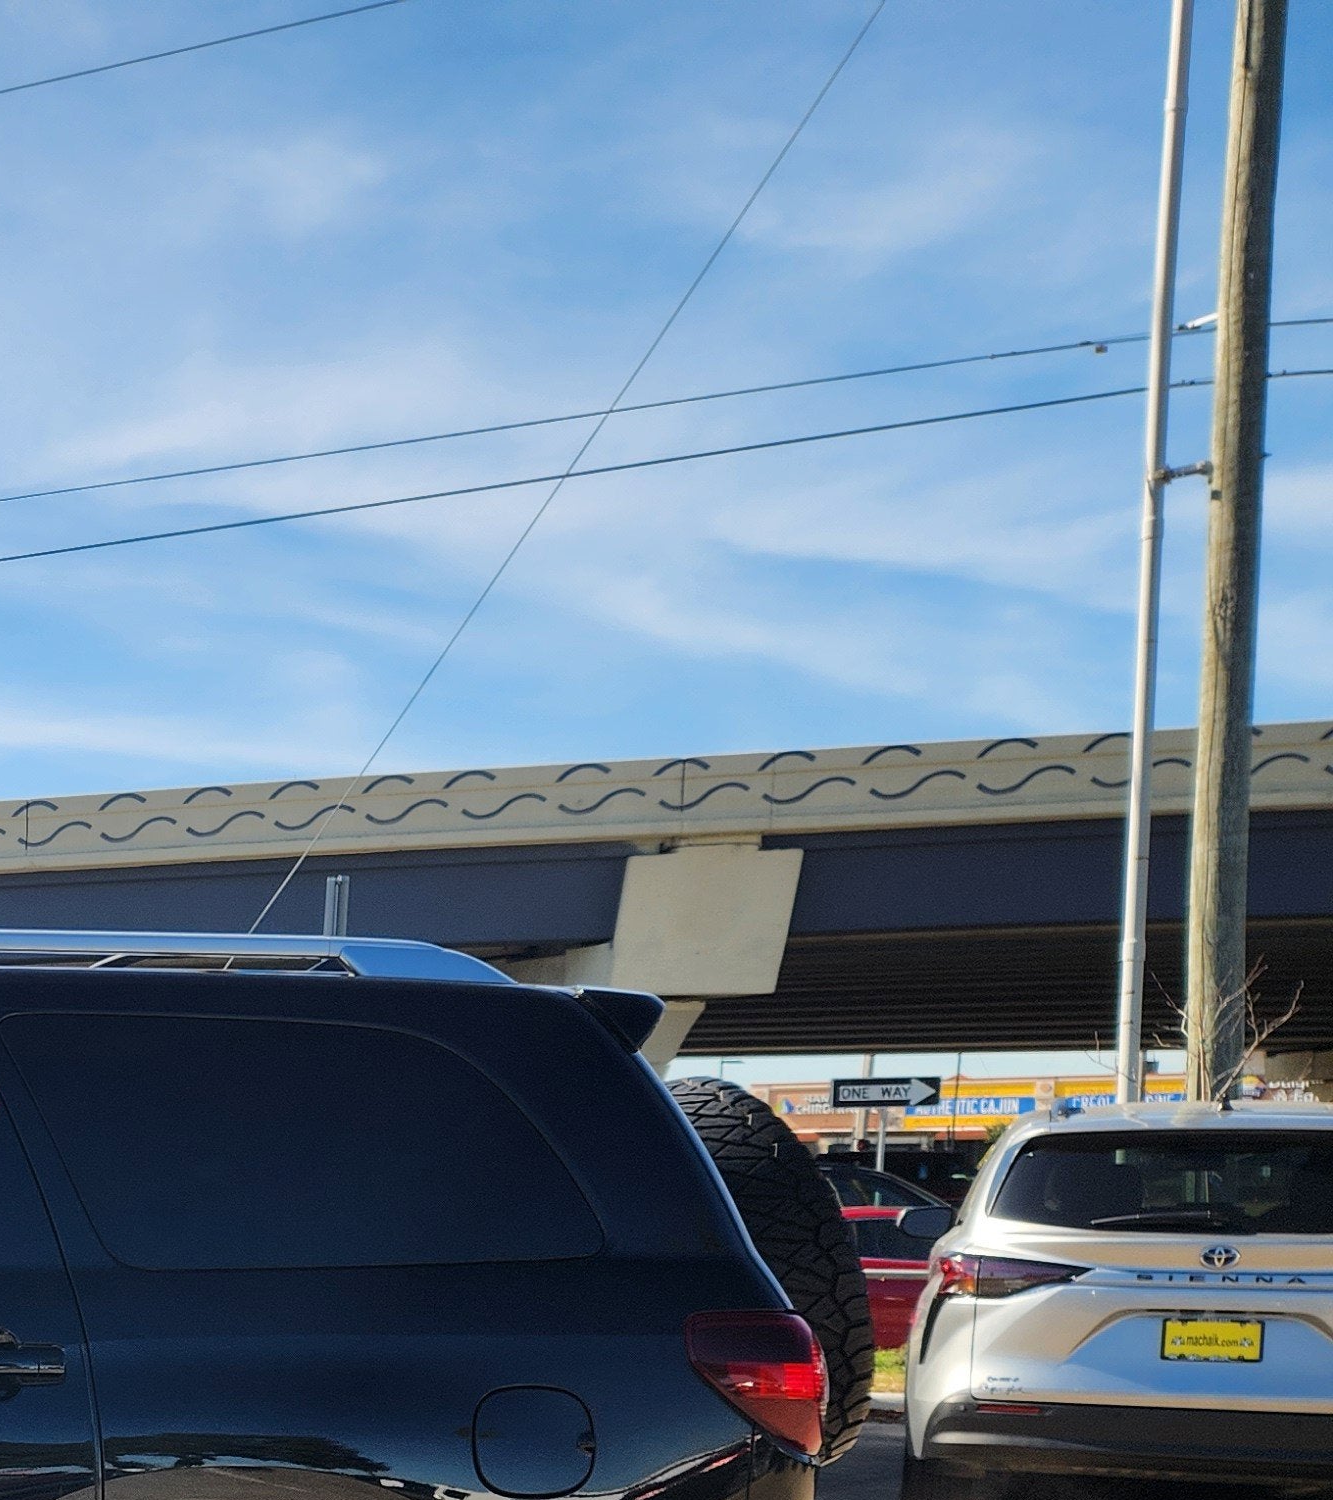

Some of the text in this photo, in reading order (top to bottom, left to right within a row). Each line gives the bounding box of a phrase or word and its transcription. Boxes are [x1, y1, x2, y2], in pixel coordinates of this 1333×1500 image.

[841, 1085, 911, 1100] ONE WAY
[980, 1097, 1019, 1115] CAJUN
[1136, 1274, 1306, 1285] SIENNA
